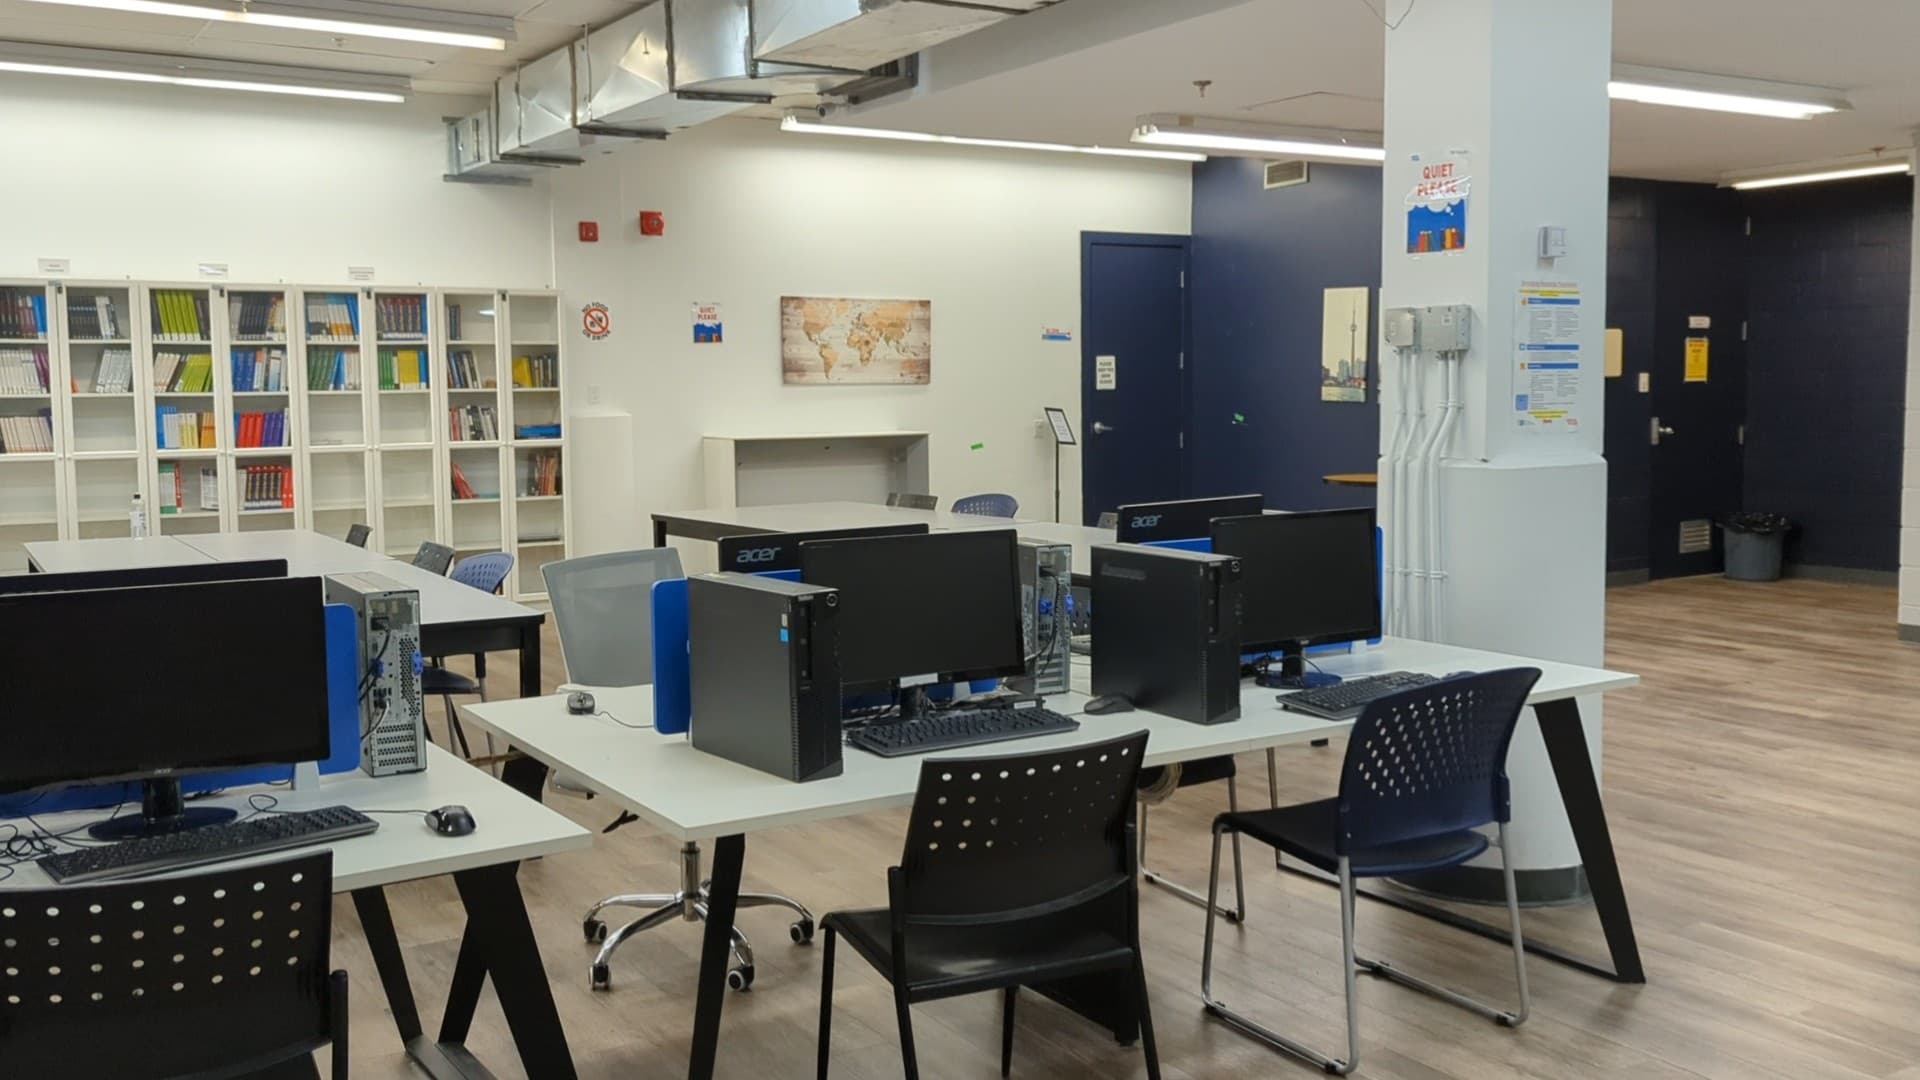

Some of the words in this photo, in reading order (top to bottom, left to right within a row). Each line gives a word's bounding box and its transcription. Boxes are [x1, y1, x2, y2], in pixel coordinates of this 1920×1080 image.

[1423, 163, 1454, 179] QUIET
[1131, 514, 1162, 528] acer
[736, 547, 781, 563] acer
